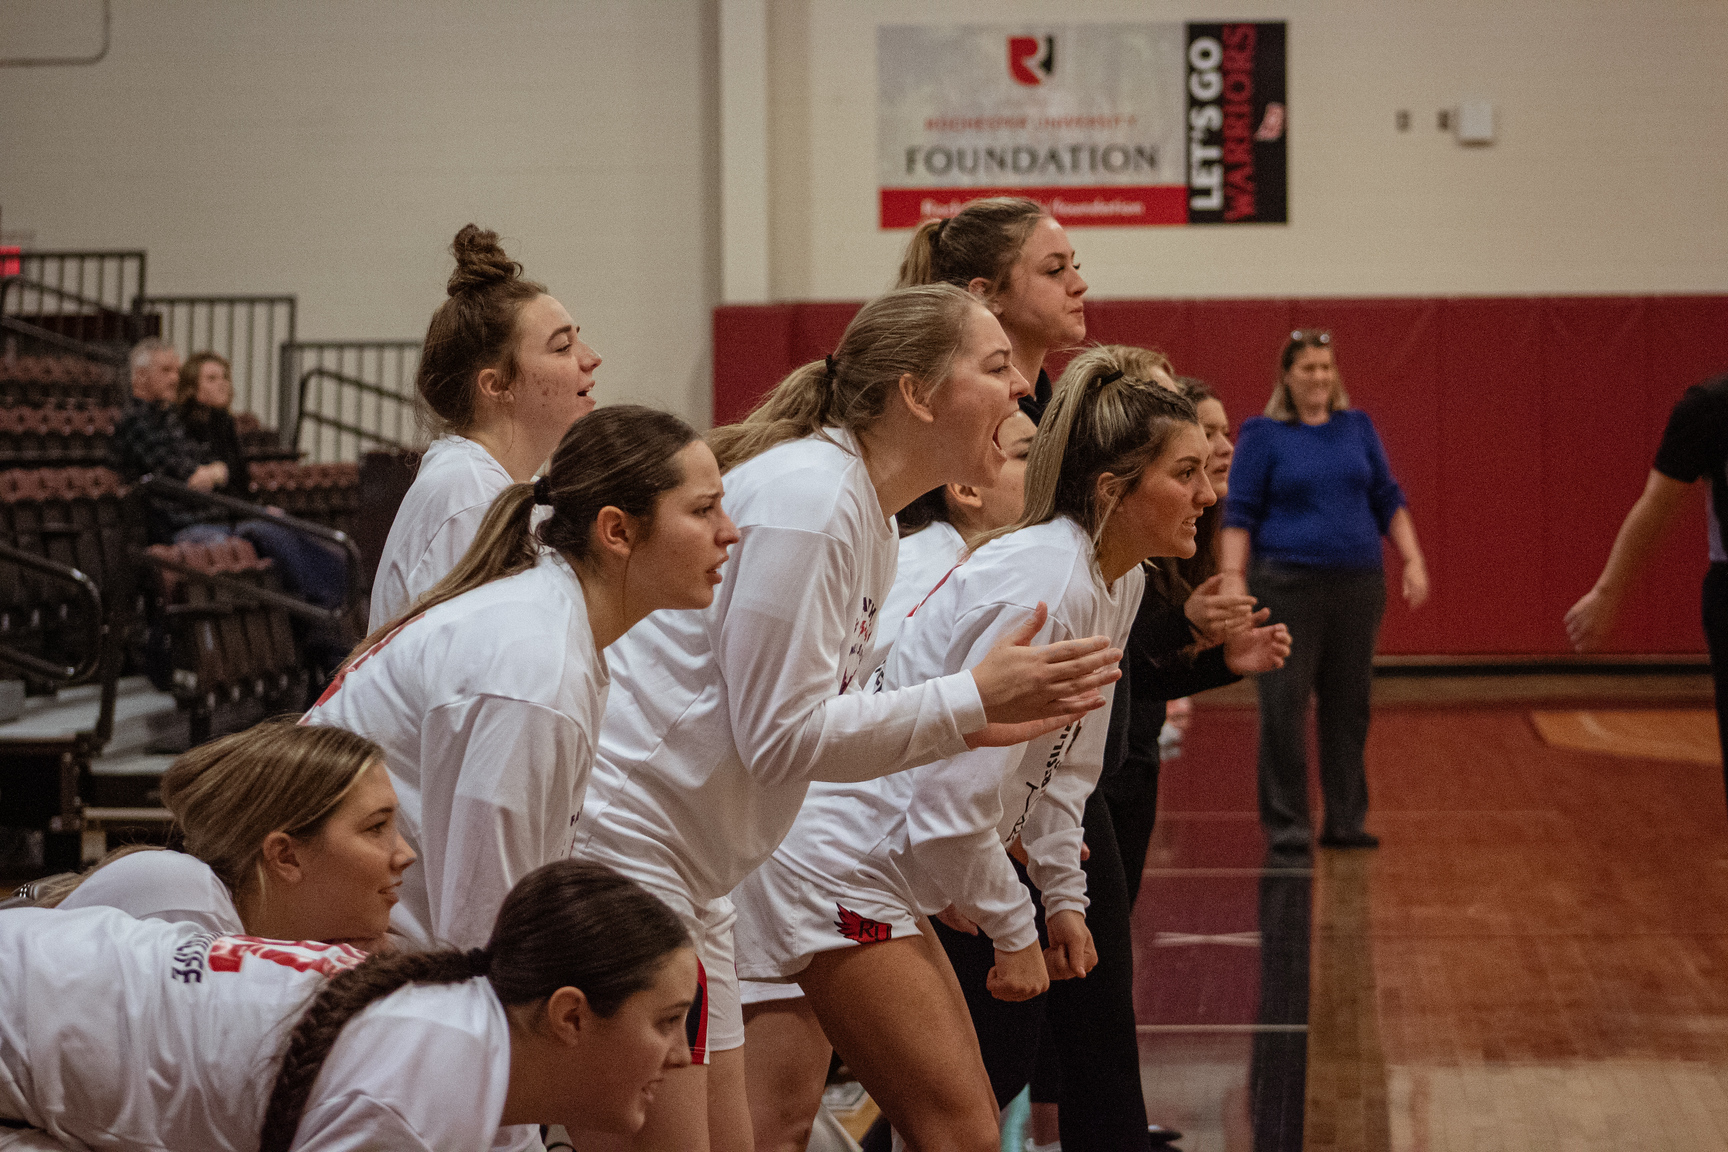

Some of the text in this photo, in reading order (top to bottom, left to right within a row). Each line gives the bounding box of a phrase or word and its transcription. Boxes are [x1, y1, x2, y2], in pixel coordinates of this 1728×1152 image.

[904, 144, 1161, 176] FOUNDATION
[1189, 36, 1223, 210] LET'S GO
[1223, 23, 1255, 222] WARRIORS
